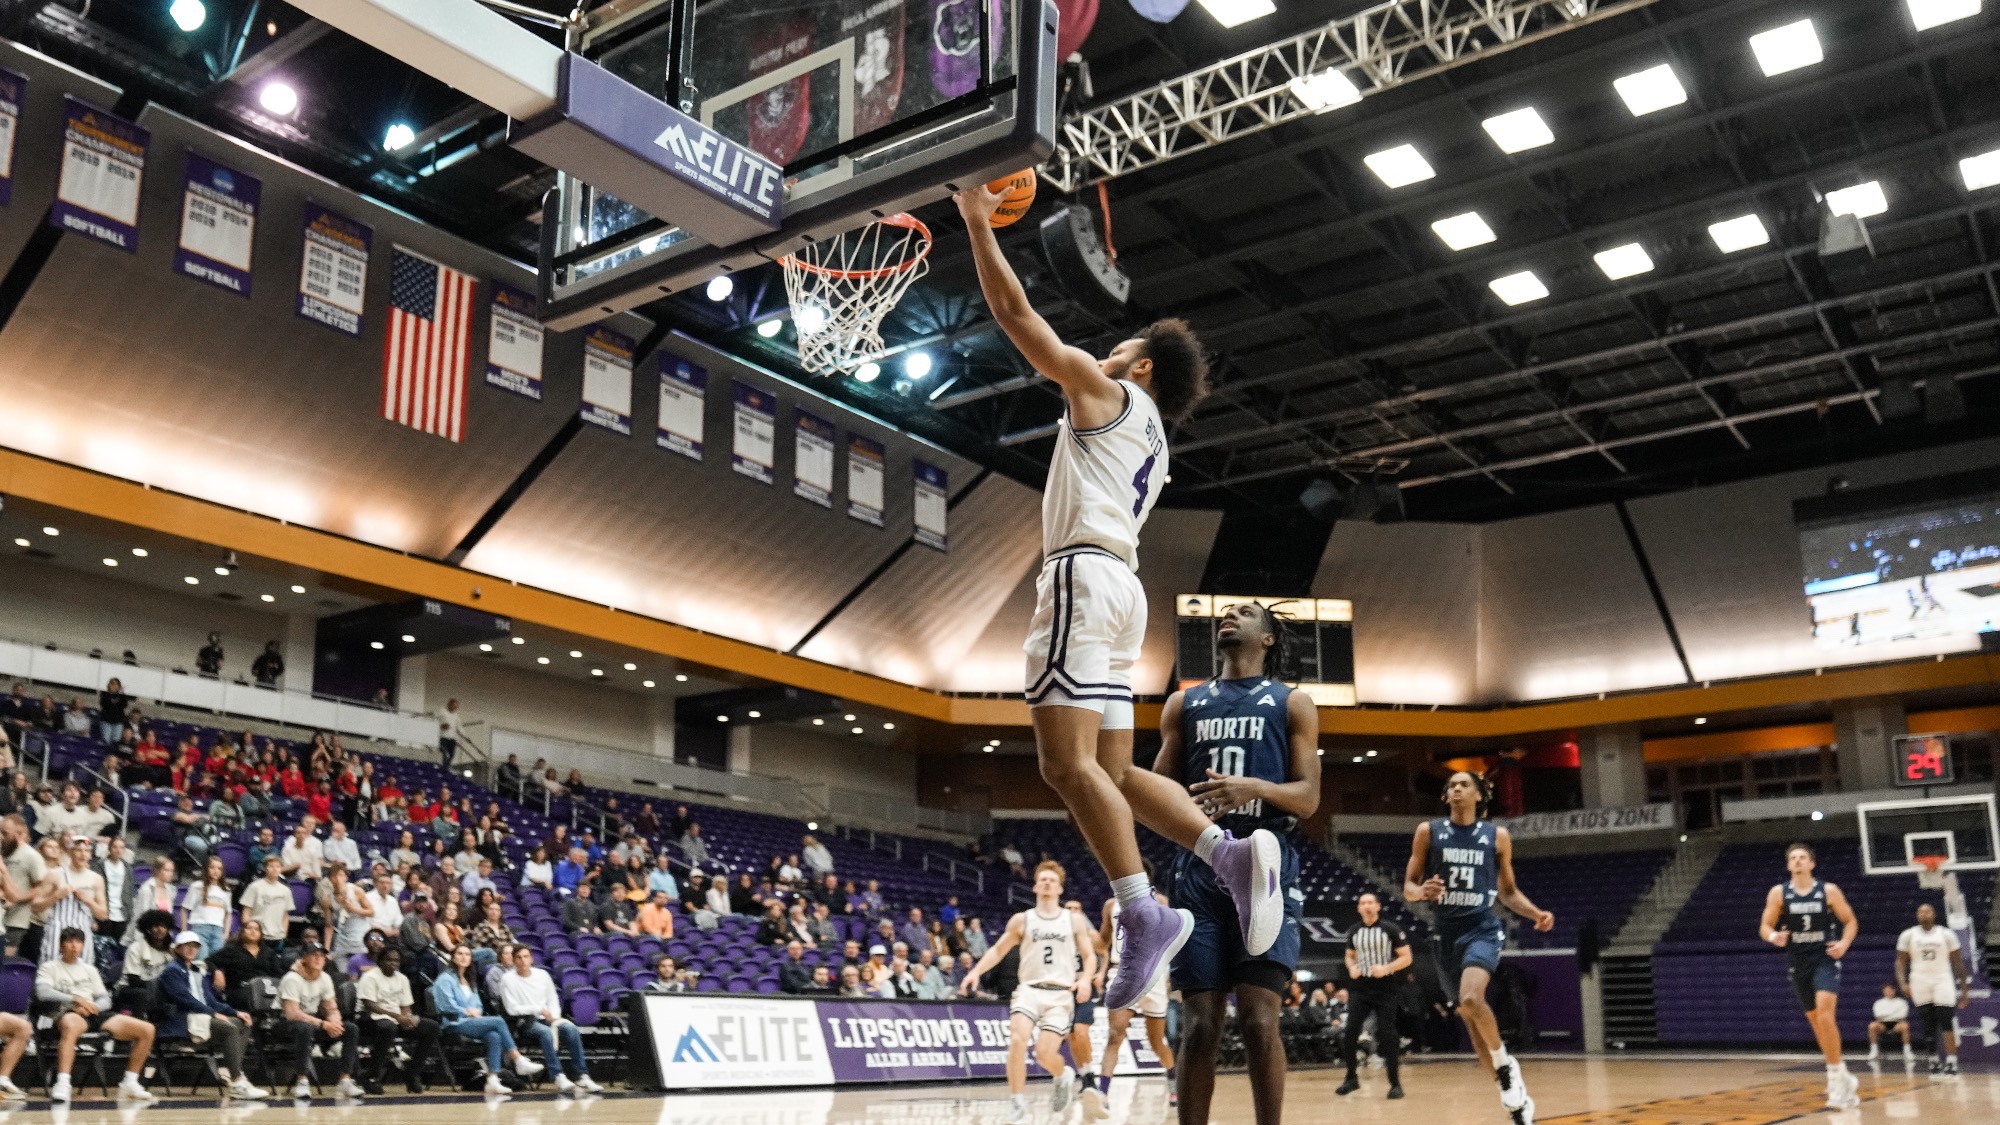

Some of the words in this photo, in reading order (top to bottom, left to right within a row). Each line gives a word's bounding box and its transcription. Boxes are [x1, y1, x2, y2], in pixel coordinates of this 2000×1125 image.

[65, 128, 144, 168] CHAMPIONS
[674, 161, 698, 180] SPORTS
[698, 174, 728, 196] MEDICINE
[691, 131, 780, 207] ELITE
[63, 214, 126, 247] SOFTBALL
[184, 260, 242, 291] SOFTBALL
[1132, 454, 1156, 519] 4
[1196, 716, 1265, 743] NORTH
[1208, 746, 1245, 783] 10
[1907, 752, 1942, 779] 24
[1568, 807, 1612, 829] KIDS
[1612, 804, 1664, 828] ZONE
[1442, 847, 1485, 865] NORTH
[1449, 866, 1475, 890] 24
[1437, 891, 1484, 907] FLORIDA
[1043, 946, 1053, 965] 2
[709, 1016, 812, 1062] ELITE
[827, 1018, 974, 1048] LIPSCOMB
[865, 1053, 911, 1067] ALLEN
[911, 1052, 957, 1066] ARENA
